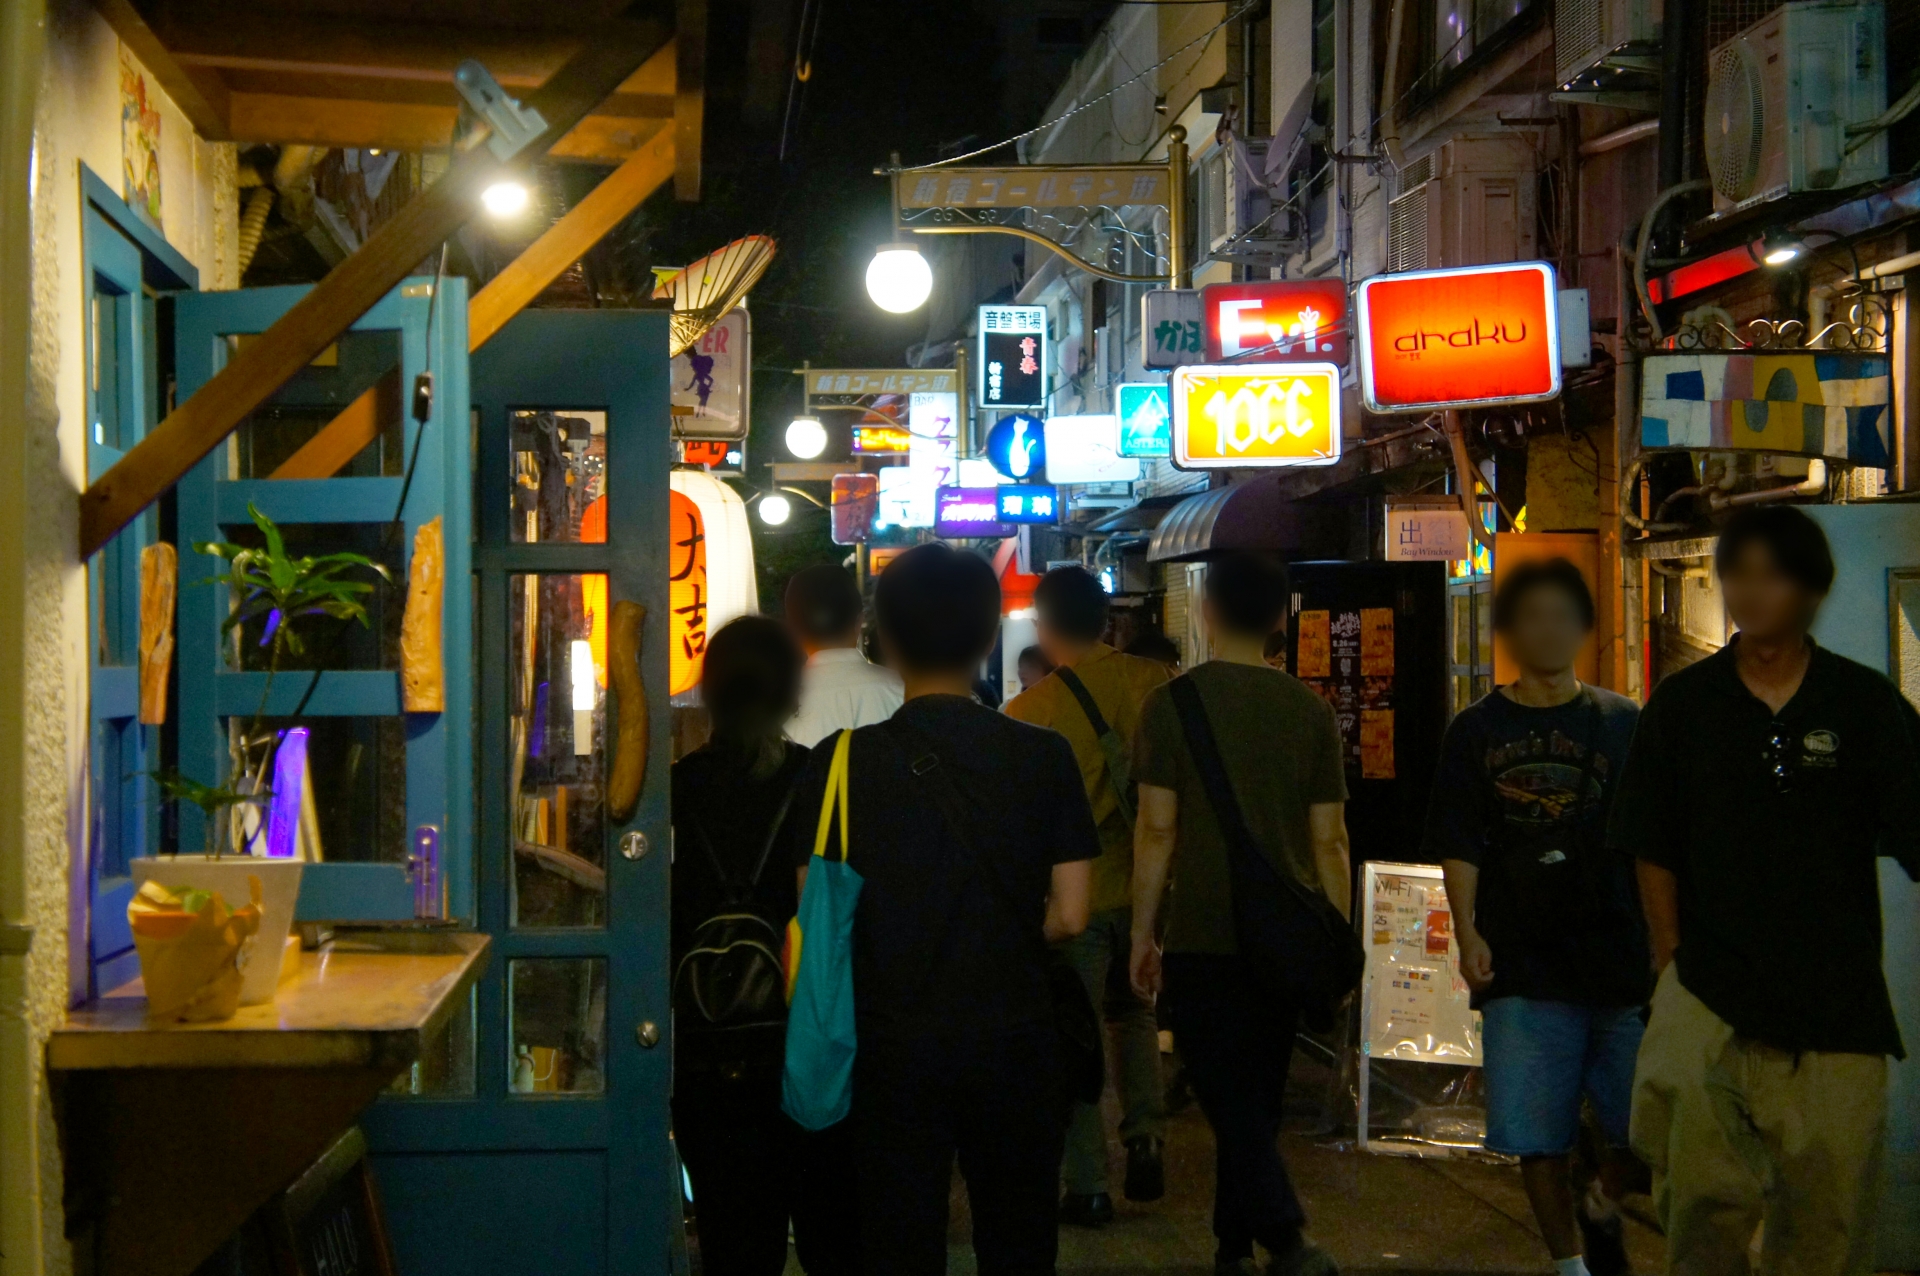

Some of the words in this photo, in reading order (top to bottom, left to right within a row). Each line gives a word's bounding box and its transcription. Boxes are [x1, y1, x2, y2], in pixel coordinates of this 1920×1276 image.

[912, 176, 1158, 205] 新宿ゴールデン街
[985, 311, 1041, 329] 音盤酒場
[1394, 316, 1527, 352] araku
[1019, 336, 1039, 375] 青春
[816, 375, 949, 392] 新宿ゴールデン街
[1124, 437, 1168, 449] ASTERI
[1401, 548, 1417, 557] Bay
[1419, 547, 1455, 557] Window
